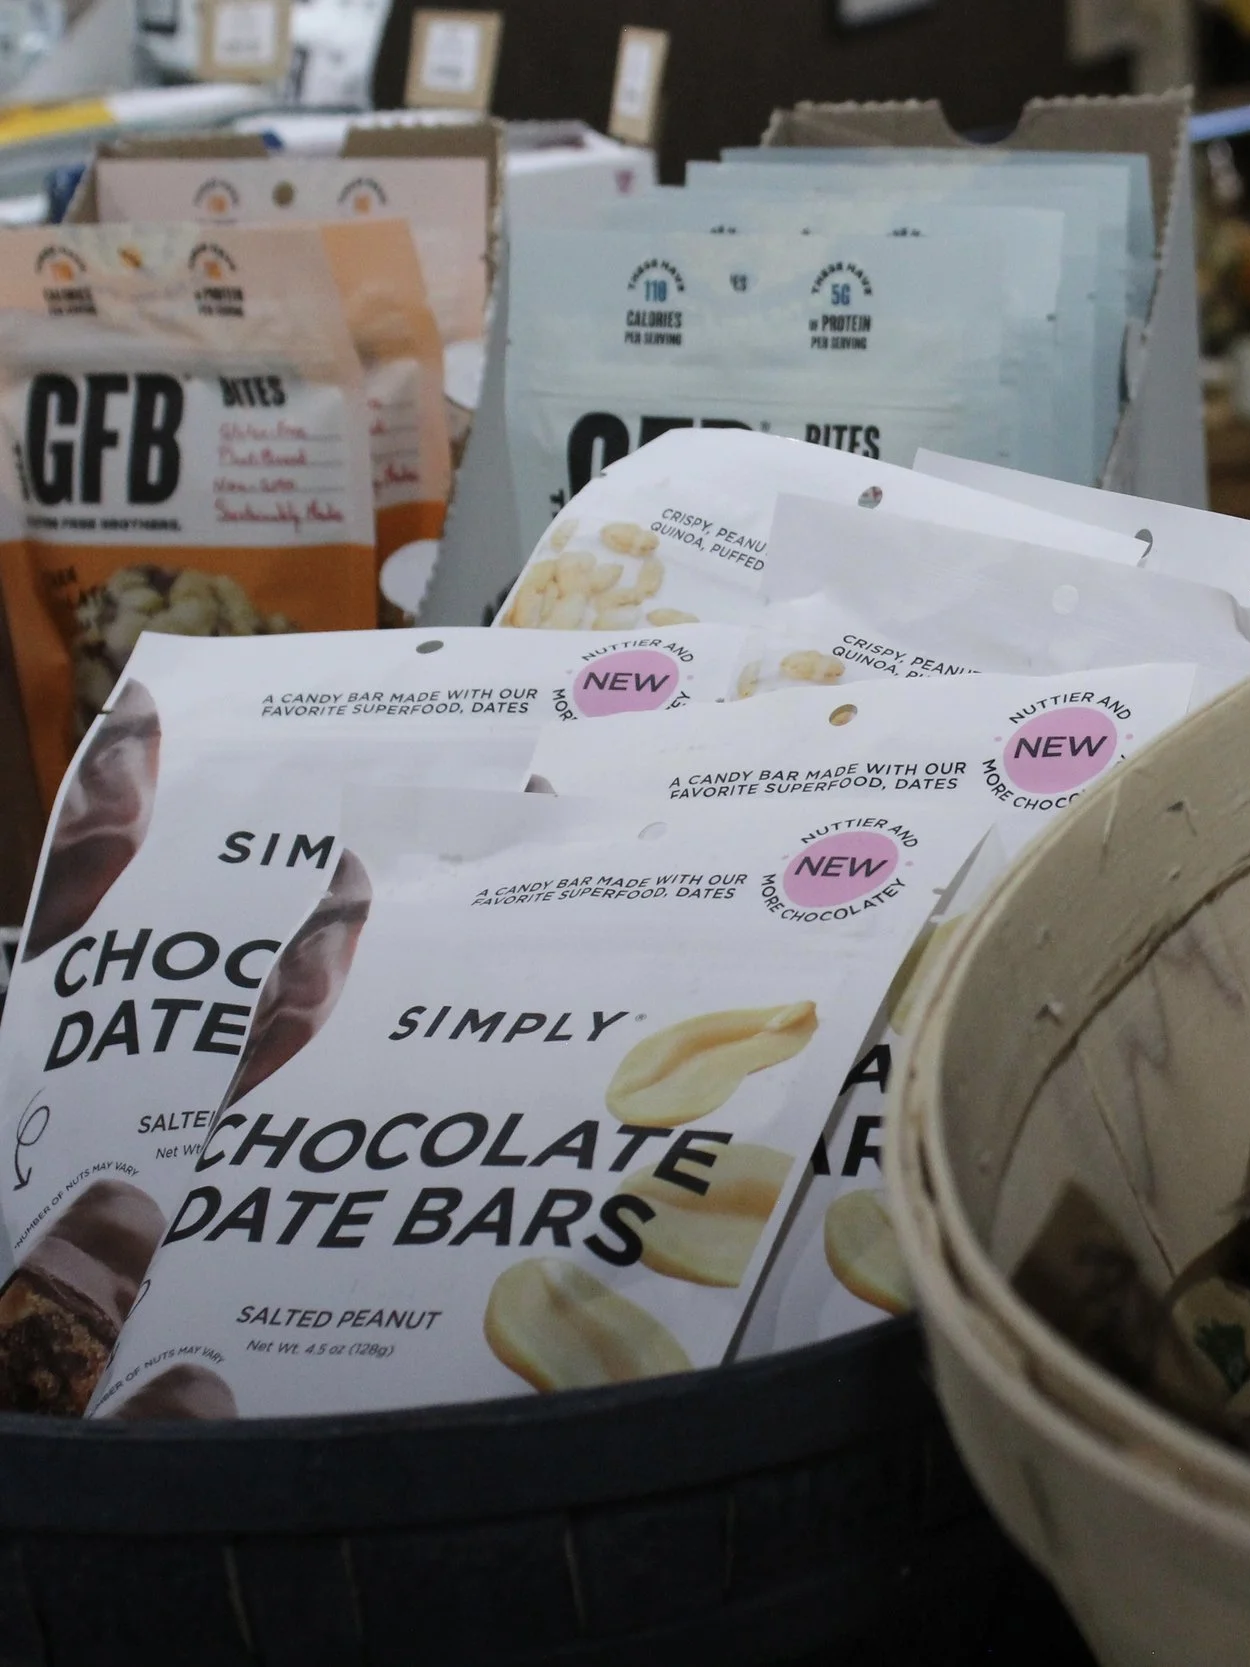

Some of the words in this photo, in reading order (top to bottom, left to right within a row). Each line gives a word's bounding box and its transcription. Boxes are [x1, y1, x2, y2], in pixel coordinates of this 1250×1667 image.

[830, 283, 851, 306] 5G
[626, 309, 683, 330] CALORIES
[821, 314, 872, 333] PROTEIN
[624, 331, 641, 345] PER
[810, 336, 828, 350] PER
[28, 373, 184, 506] GFB
[662, 508, 713, 535] CRISPY,
[716, 527, 768, 556] PEANU
[650, 521, 705, 551] QUINOA,
[709, 543, 765, 571] PUFFED
[581, 639, 662, 661] NUTTIER
[663, 642, 694, 663] AND
[832, 646, 899, 677] QUINOA,
[843, 634, 907, 663] CRISPY,
[583, 672, 670, 692] NEW
[261, 705, 347, 717] FAVORITE
[352, 702, 464, 716] SUPERFOOD,
[471, 702, 529, 713] DATES
[262, 694, 275, 704] A
[280, 694, 343, 705] CANDY
[346, 692, 384, 703] BAR
[389, 691, 441, 704] MADE
[446, 689, 494, 700] WITH
[499, 688, 538, 700] OUR
[552, 688, 578, 721] MOR
[1009, 692, 1095, 724] NUTTIER
[1097, 696, 1131, 720] AND
[1014, 736, 1108, 759] NEW
[669, 777, 681, 789] A
[688, 771, 753, 786] CANDY
[758, 770, 799, 781] BAR
[805, 763, 859, 780] MADE
[866, 763, 918, 776] WITH
[925, 762, 967, 775] OUR
[670, 783, 759, 799] FAVORITE
[764, 776, 887, 793] SUPERFOOD,
[894, 778, 958, 790] DATES
[983, 758, 1014, 801] MORE
[801, 818, 888, 843] NUTTIER
[888, 825, 918, 848] AND
[794, 856, 888, 878] NEW
[471, 892, 554, 906] FAVORITE
[558, 887, 668, 900] SUPERFOOD,
[675, 887, 737, 899] DATES
[476, 889, 489, 897] A
[495, 881, 554, 896] CANDY
[556, 876, 593, 888] BAR
[597, 876, 652, 888] MADE
[655, 874, 703, 886] WITH
[708, 874, 748, 885] OUR
[761, 873, 785, 913] MORE
[781, 878, 906, 923] CHOCOLATEY
[43, 998, 252, 1072] DATE
[388, 1005, 631, 1043] SIMPLY
[138, 1111, 216, 1134] SALTE
[156, 1148, 178, 1160] Net
[195, 1112, 734, 1196] CHOCOLATE
[52, 1192, 64, 1207] OF
[66, 1169, 90, 1192] NUTS
[92, 1161, 113, 1173] MAY
[115, 1162, 140, 1177] VARY
[161, 1185, 389, 1249] DATE
[392, 1186, 657, 1267] BARS
[236, 1305, 333, 1329] SALTED
[336, 1309, 444, 1331] PEANUT
[246, 1340, 273, 1353] Net
[305, 1343, 328, 1356] 4.5
[328, 1344, 347, 1356] oz
[348, 1342, 396, 1359] (128g)
[125, 1367, 141, 1383] OF
[144, 1349, 175, 1369] NUTS
[177, 1346, 202, 1356] MAY
[201, 1347, 226, 1365] VARY
